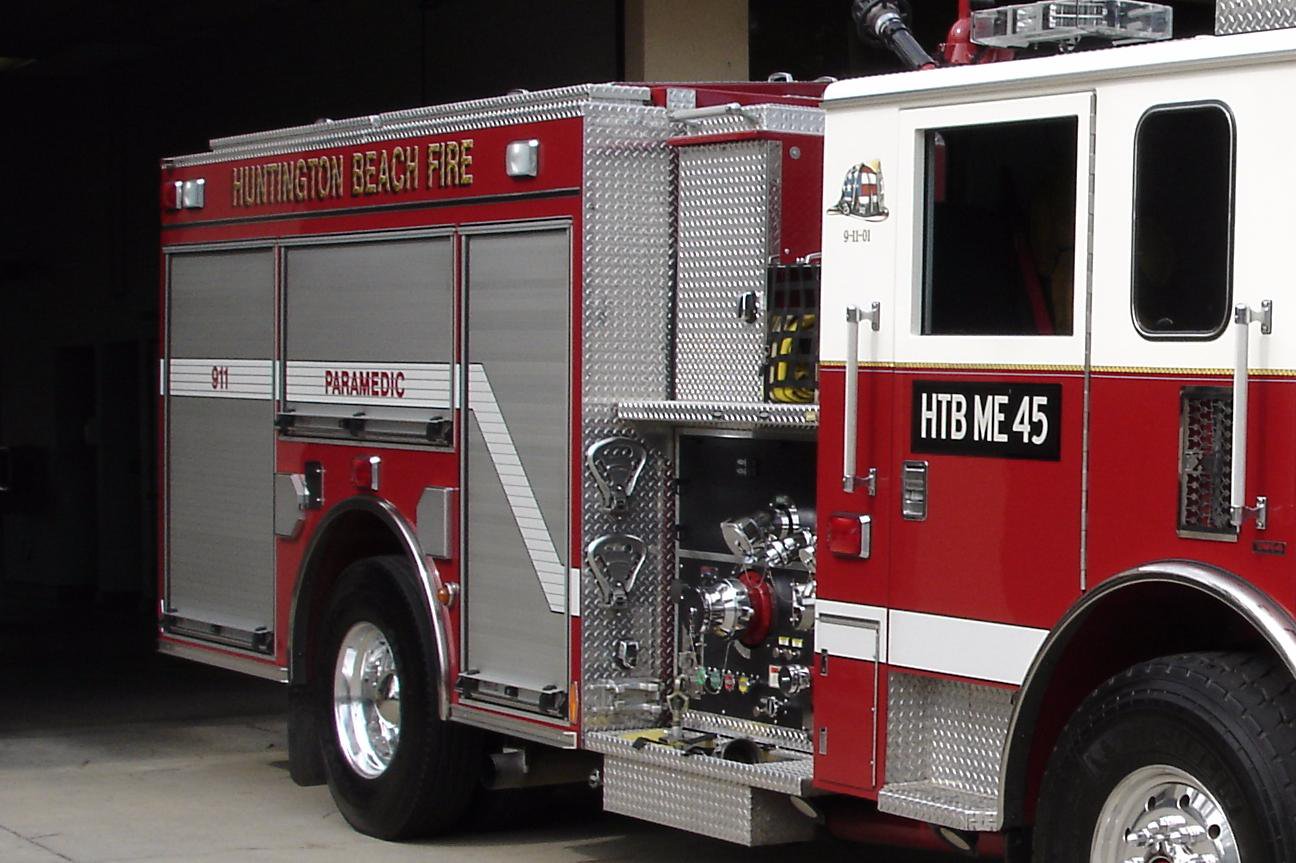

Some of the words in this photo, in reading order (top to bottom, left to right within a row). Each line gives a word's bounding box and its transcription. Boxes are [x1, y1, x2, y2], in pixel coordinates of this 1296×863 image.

[232, 155, 344, 207] HUNTINGTON
[352, 145, 420, 195] BEACH
[426, 138, 474, 188] FIRE
[843, 229, 871, 243] 9-11-01
[211, 365, 229, 390] 911
[324, 370, 405, 399] PARAMEDIC
[920, 392, 967, 440] HTB
[973, 394, 1009, 443] ME
[1012, 395, 1049, 445] 45
